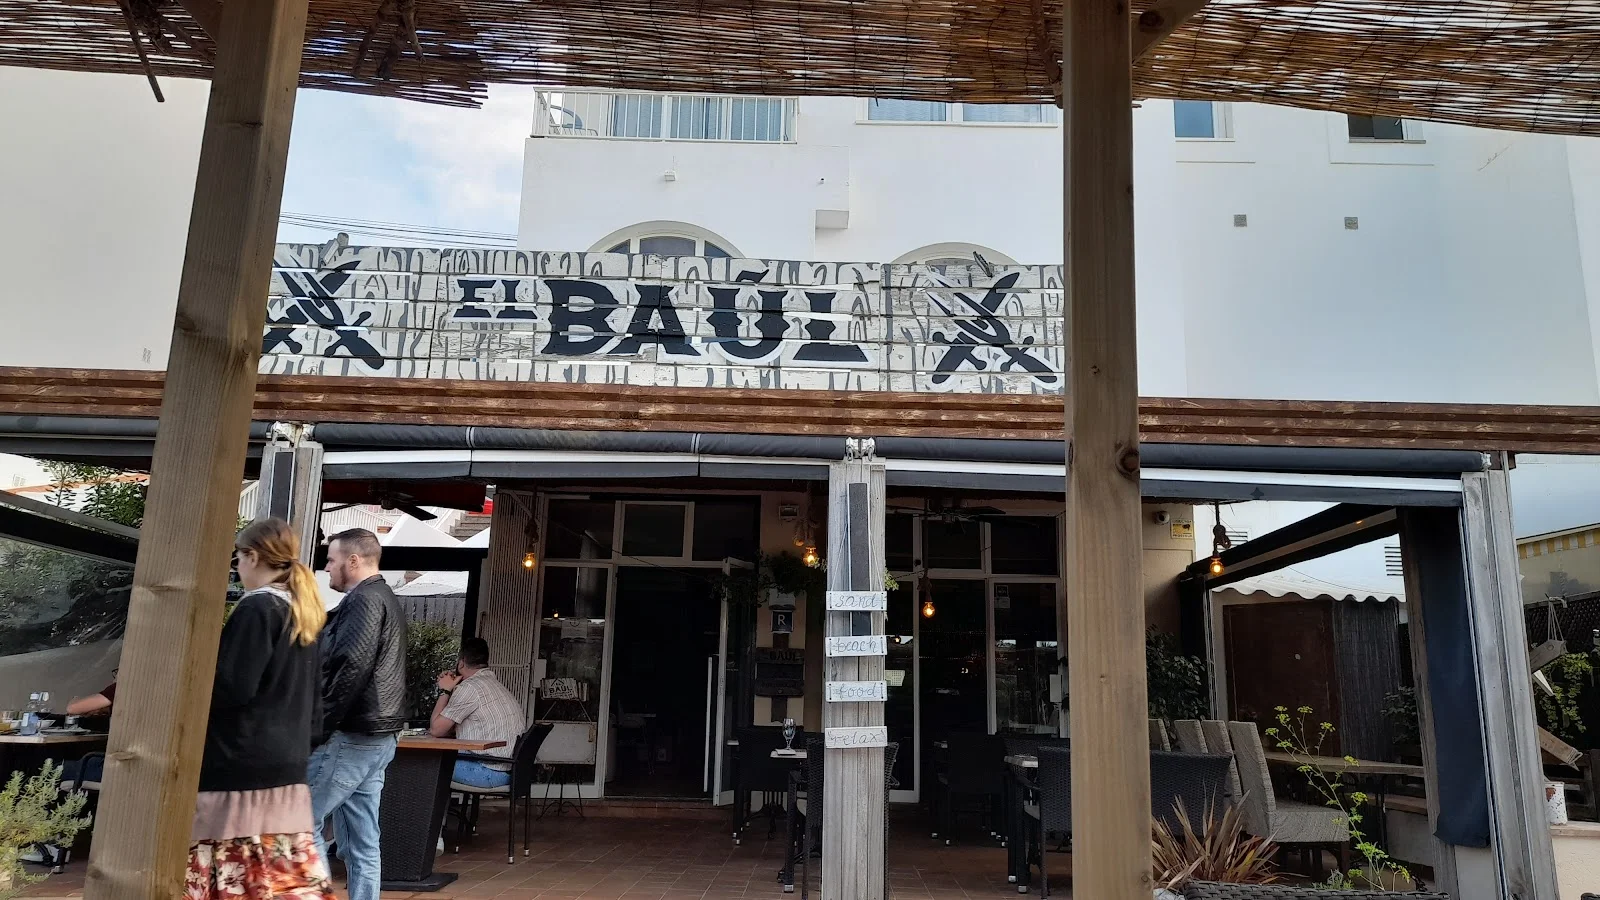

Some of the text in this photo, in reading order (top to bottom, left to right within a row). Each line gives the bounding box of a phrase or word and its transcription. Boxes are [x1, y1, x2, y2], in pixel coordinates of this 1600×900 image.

[453, 279, 538, 318] EL
[835, 593, 878, 608] sand
[778, 614, 786, 626] R
[834, 637, 878, 653] beach
[839, 682, 877, 700] food
[830, 730, 877, 746] relax
